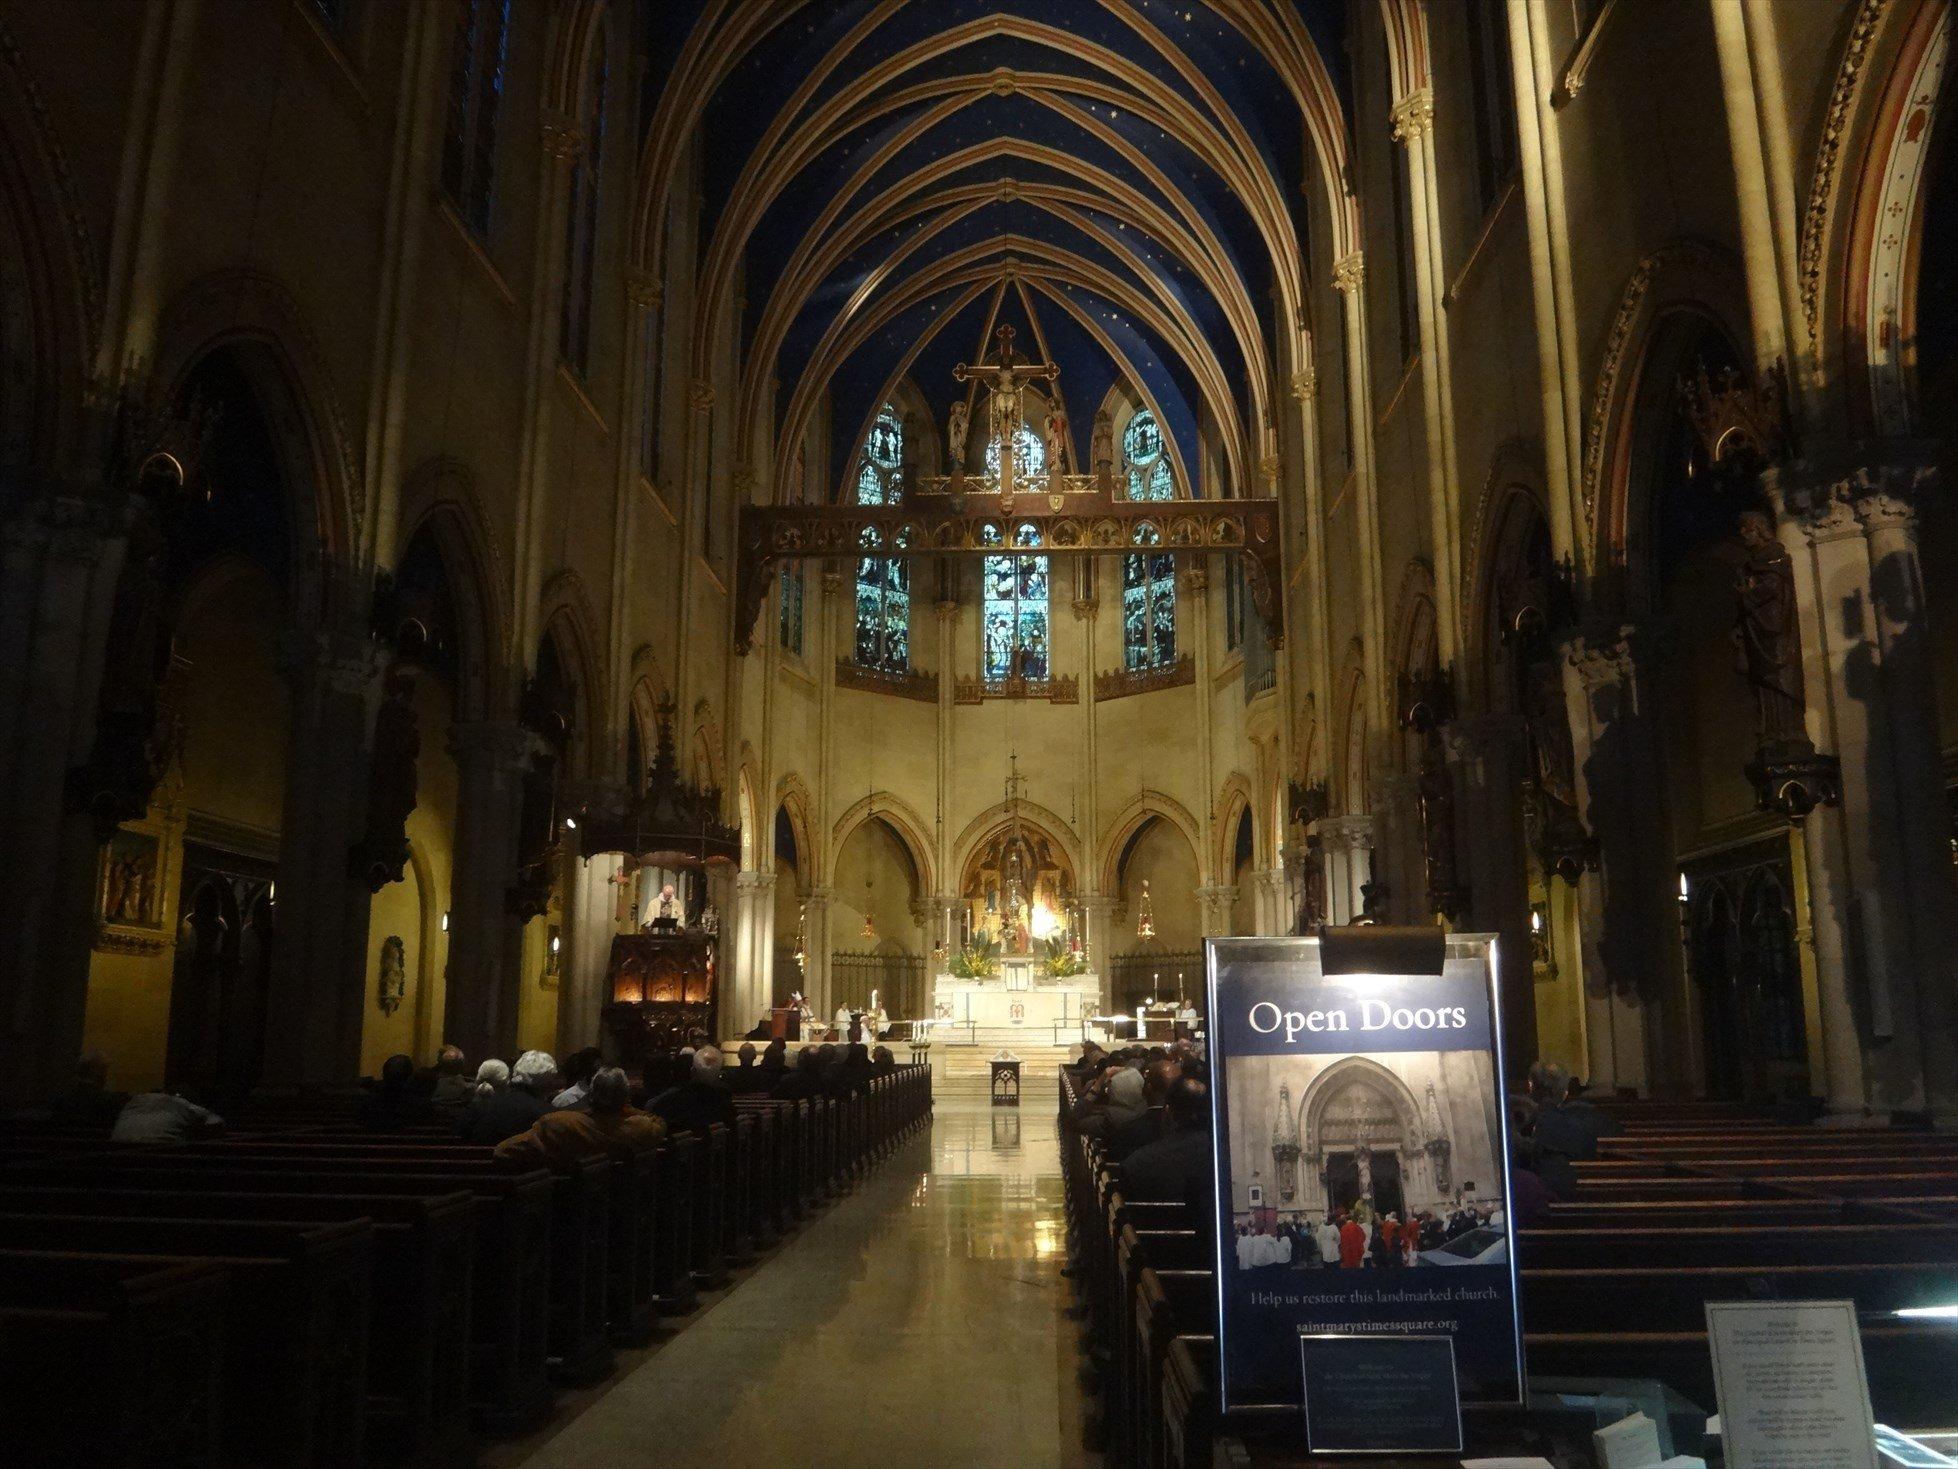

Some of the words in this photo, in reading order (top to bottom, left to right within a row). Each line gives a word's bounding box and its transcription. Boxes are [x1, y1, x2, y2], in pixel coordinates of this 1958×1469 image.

[1248, 1001, 1349, 1043] Open
[1360, 999, 1467, 1031] Doors
[1250, 1292, 1282, 1308] Help
[1285, 1296, 1299, 1305] us
[1302, 1293, 1346, 1305] restore
[1350, 1290, 1374, 1304] this
[1376, 1288, 1451, 1303] landmarked
[1296, 1318, 1459, 1335] saintmarystimessquare.org
